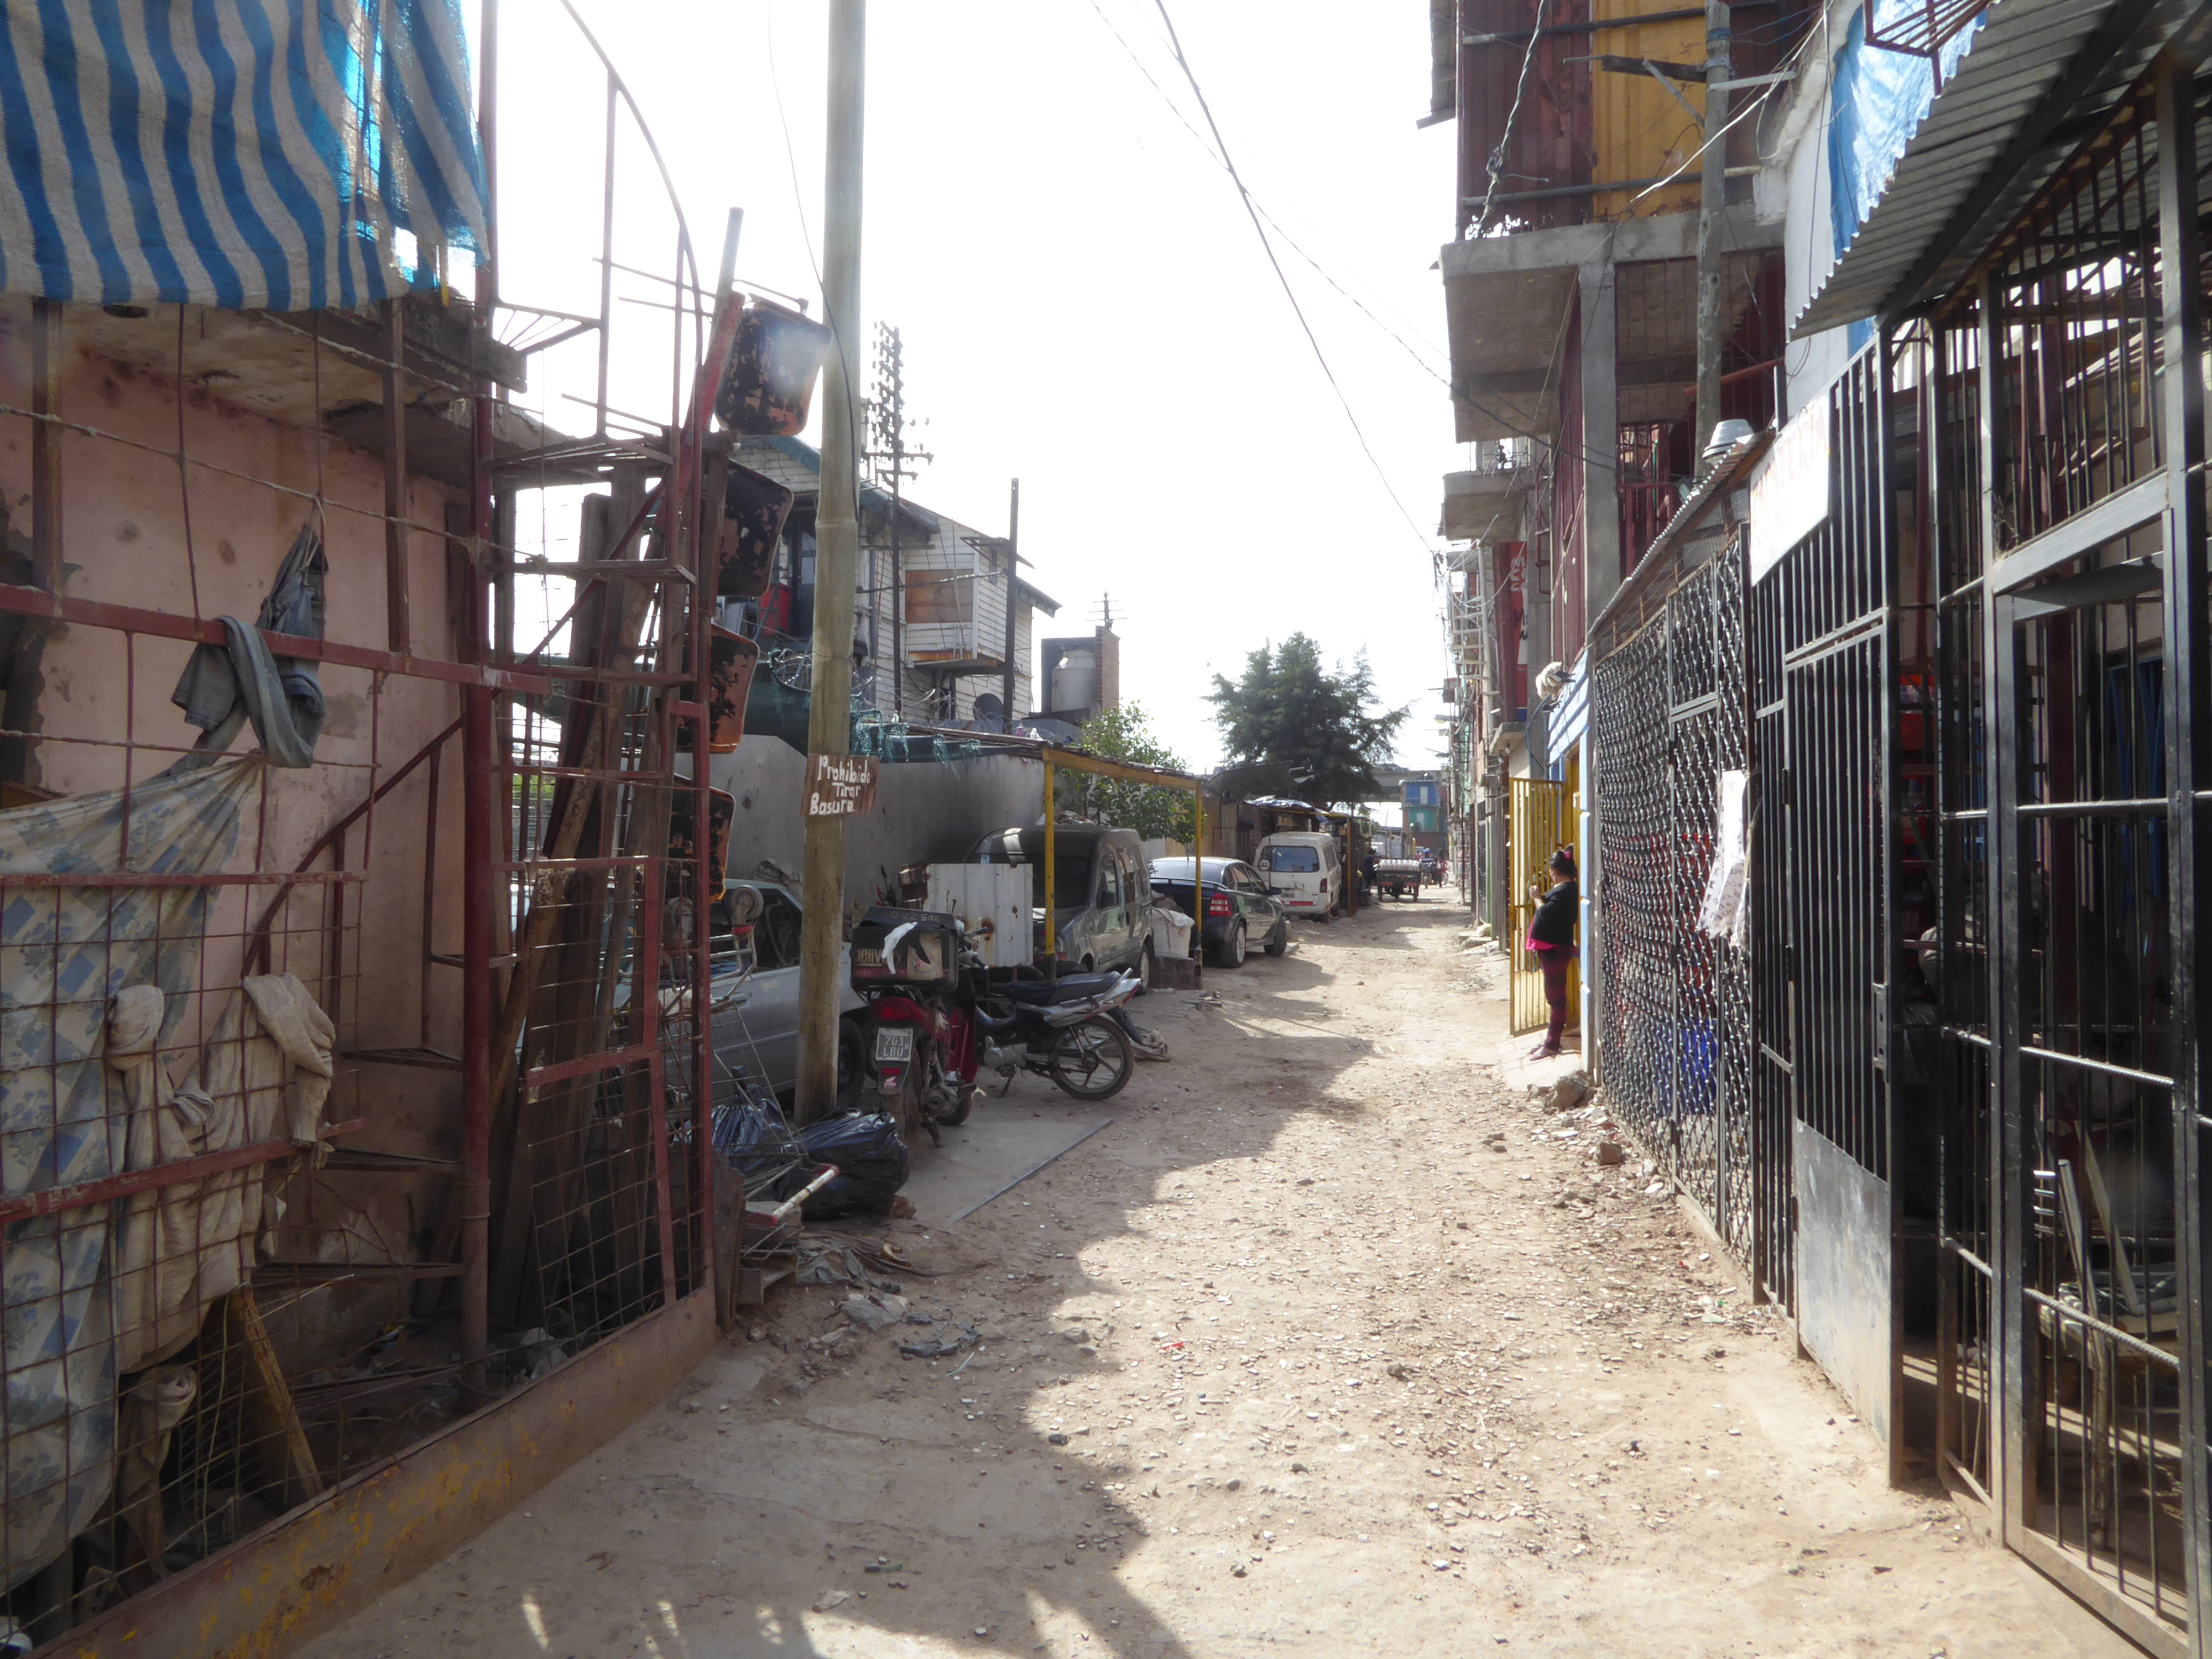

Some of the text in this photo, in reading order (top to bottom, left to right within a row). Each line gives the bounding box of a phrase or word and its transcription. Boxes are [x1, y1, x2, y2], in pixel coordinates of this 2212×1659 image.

[817, 755, 870, 784] Prohibido
[831, 781, 862, 799] Tirar
[885, 1035, 904, 1046] 701
[883, 1046, 904, 1057] LBU
